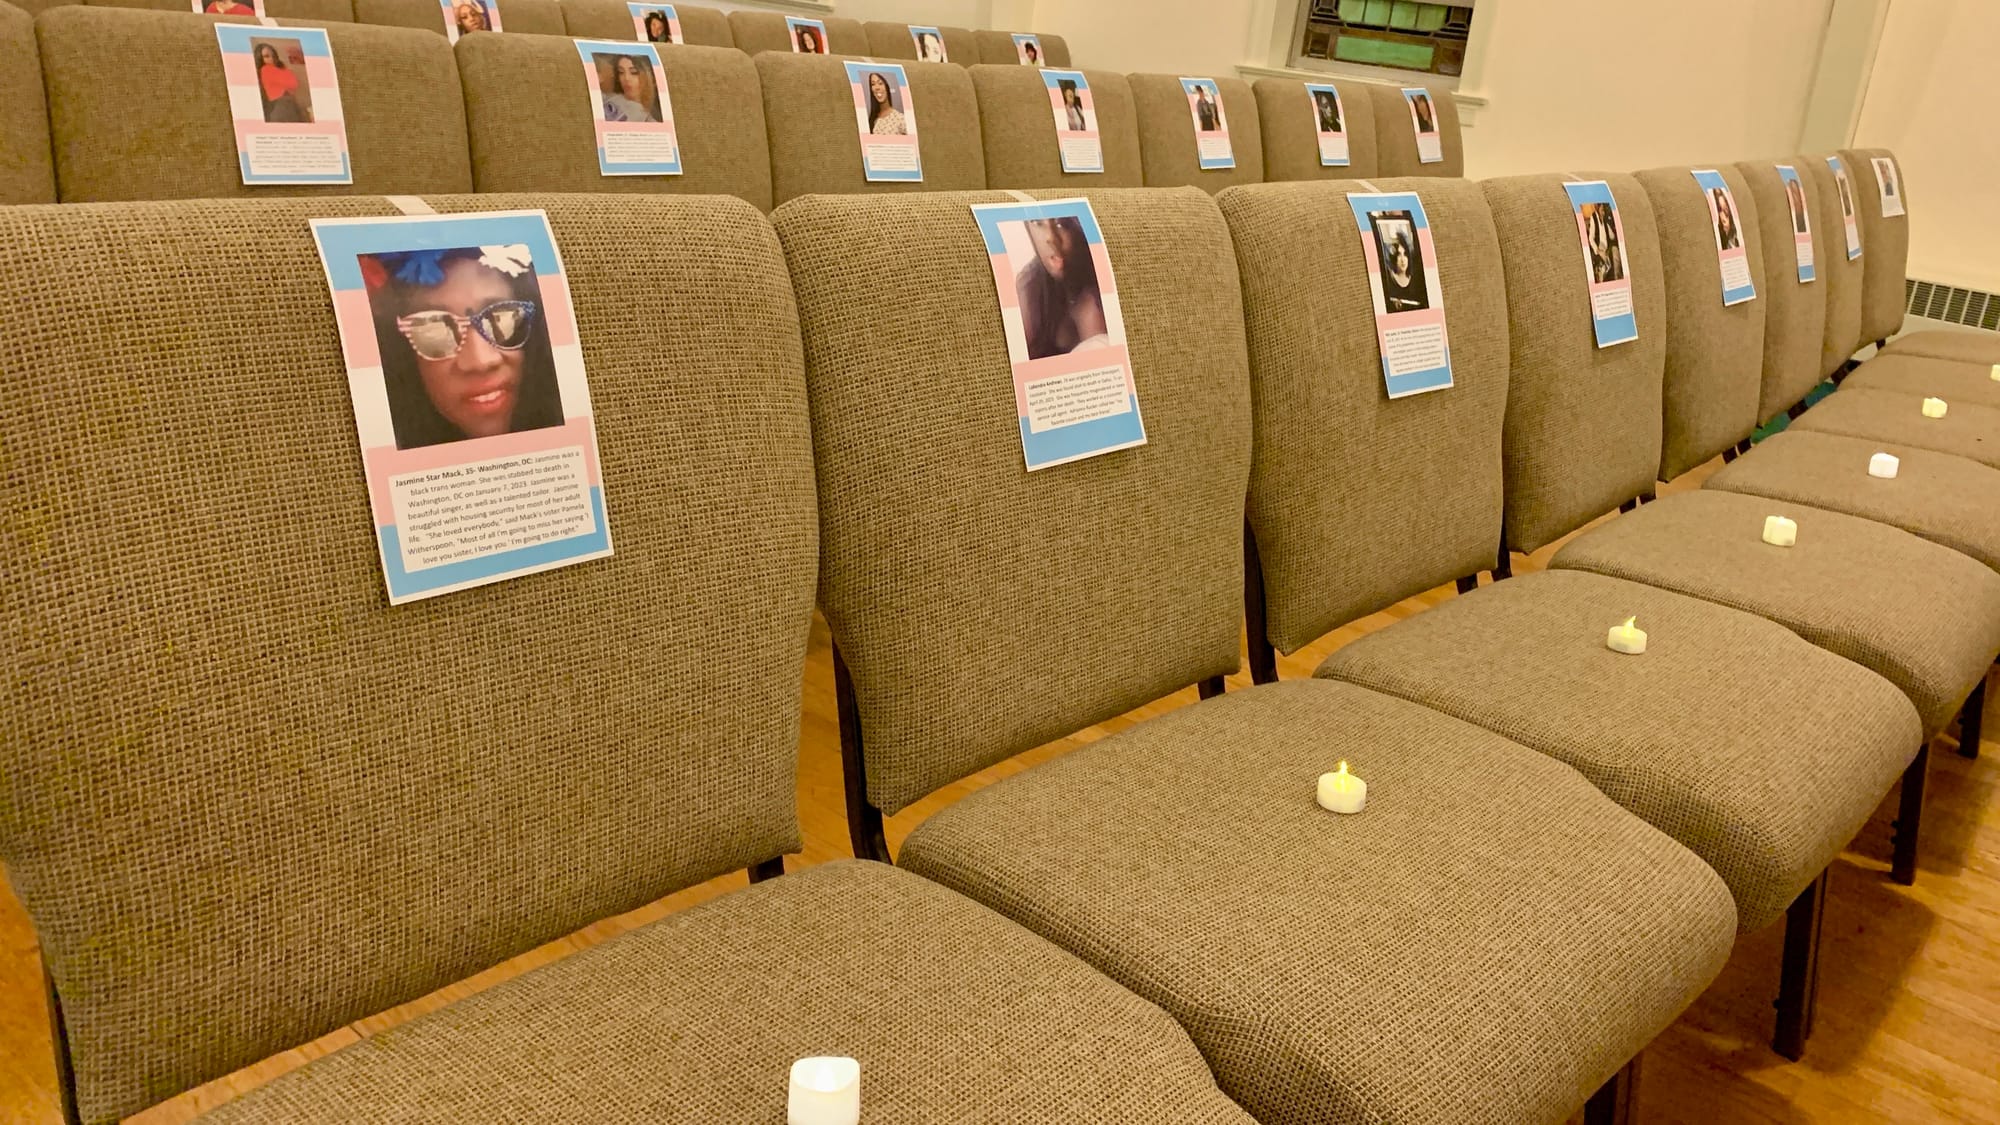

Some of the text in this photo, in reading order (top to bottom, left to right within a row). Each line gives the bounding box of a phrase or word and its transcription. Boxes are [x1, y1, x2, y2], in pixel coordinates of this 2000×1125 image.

[395, 476, 424, 486] Jasmine
[426, 473, 440, 481] Star
[442, 469, 464, 480] Mack,
[478, 460, 520, 474] Washington,
[535, 453, 560, 462] Jasmine
[410, 487, 428, 496] black
[431, 484, 448, 492] trans
[508, 469, 533, 478] stabbed
[543, 464, 561, 472] death
[408, 495, 452, 509] Washington,
[476, 486, 501, 497] January
[531, 476, 555, 485] Jasmine
[408, 509, 439, 520] beautiful
[441, 504, 463, 515] singer,
[504, 492, 531, 502] talented
[554, 483, 578, 492] Jasmine
[409, 520, 442, 533] struggled
[444, 516, 458, 524] with
[460, 511, 487, 523] housing
[489, 506, 514, 517] security
[527, 500, 543, 508] most
[565, 493, 580, 501] adult
[426, 531, 441, 540] "She
[443, 527, 462, 536] loved
[505, 516, 518, 524] said
[520, 511, 541, 521] Mack's
[544, 508, 560, 516] sister
[562, 503, 584, 512] Pamela
[457, 535, 477, 545] "Most
[509, 525, 527, 535] going
[537, 520, 550, 528] miss
[565, 514, 584, 524] saying
[423, 555, 438, 563] love
[454, 548, 473, 558] sister,
[523, 533, 541, 544] going
